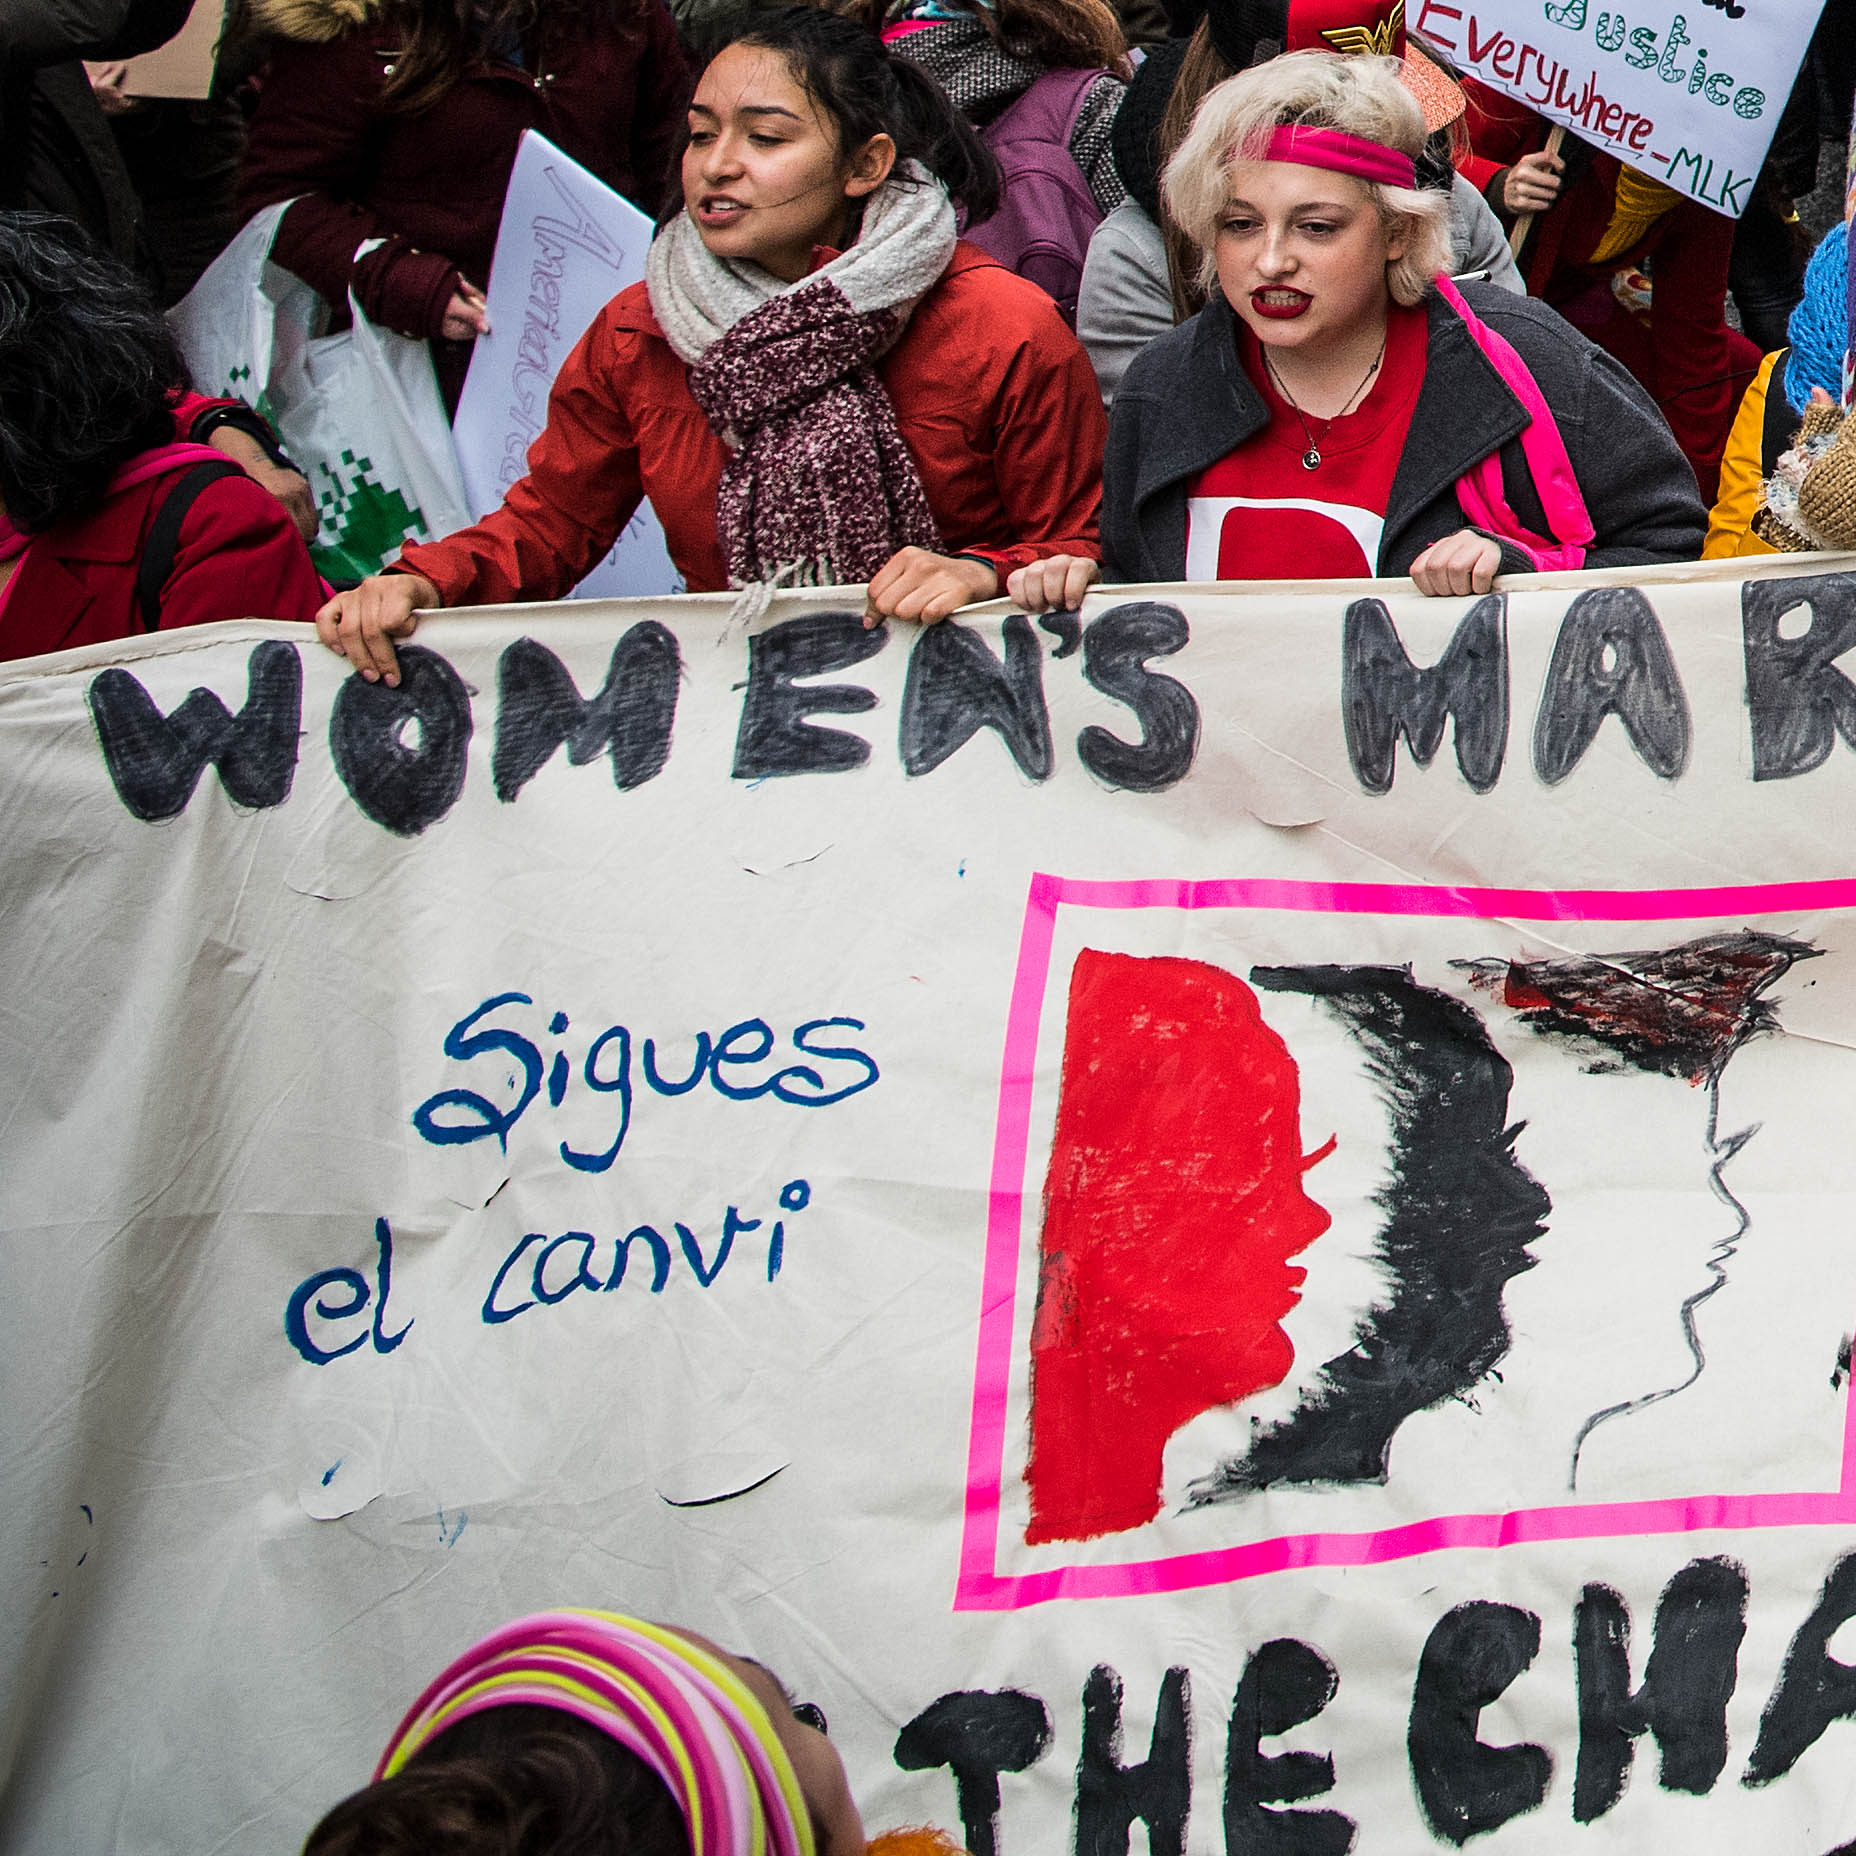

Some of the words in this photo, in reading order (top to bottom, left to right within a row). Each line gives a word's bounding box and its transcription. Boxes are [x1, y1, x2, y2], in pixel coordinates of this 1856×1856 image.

[87, 598, 1202, 839] WOMEN'S
[411, 988, 882, 1174] Sigues
[284, 1216, 415, 1368] el
[480, 1176, 812, 1329] canvi
[892, 1636, 1365, 1856] THE
